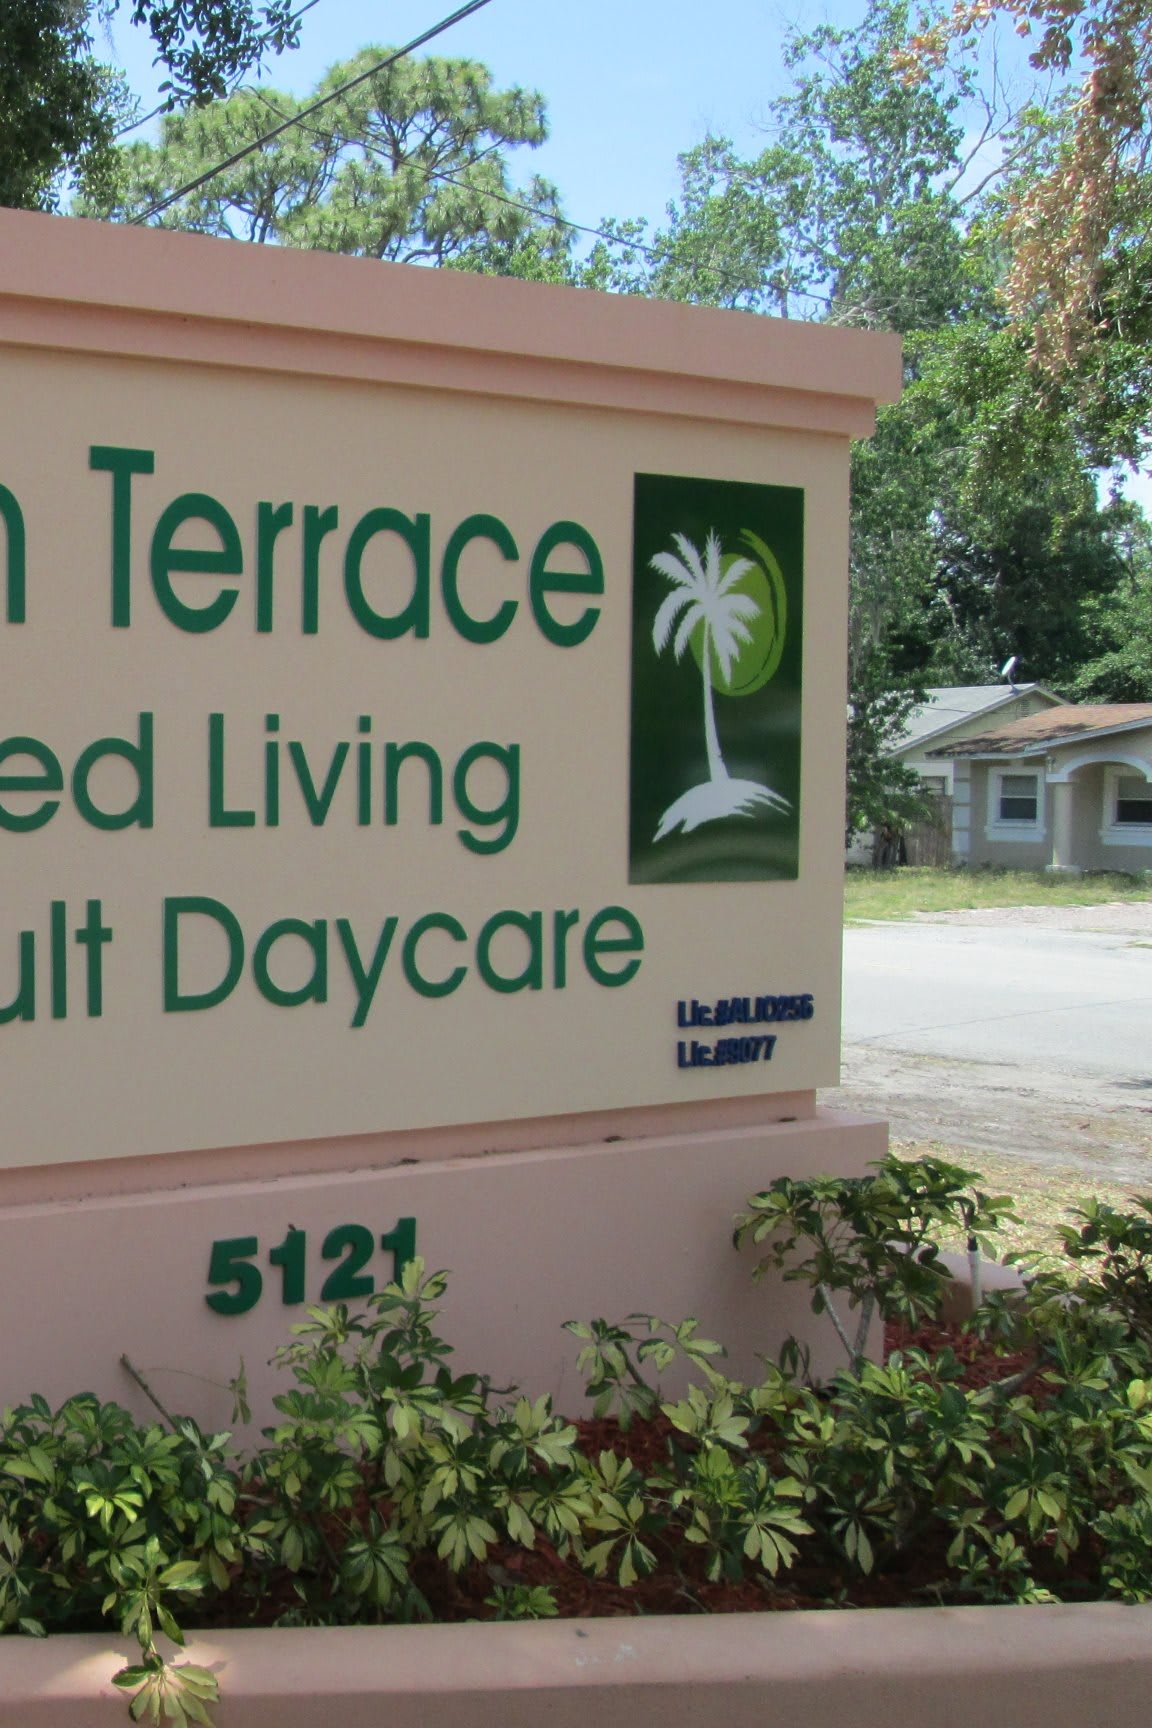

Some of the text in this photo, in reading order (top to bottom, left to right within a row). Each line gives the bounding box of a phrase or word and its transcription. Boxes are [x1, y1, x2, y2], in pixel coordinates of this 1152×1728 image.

[90, 445, 605, 647] Terrace
[209, 711, 521, 855] Living
[163, 896, 645, 1028] Daycare
[205, 1216, 417, 1316] 5121
